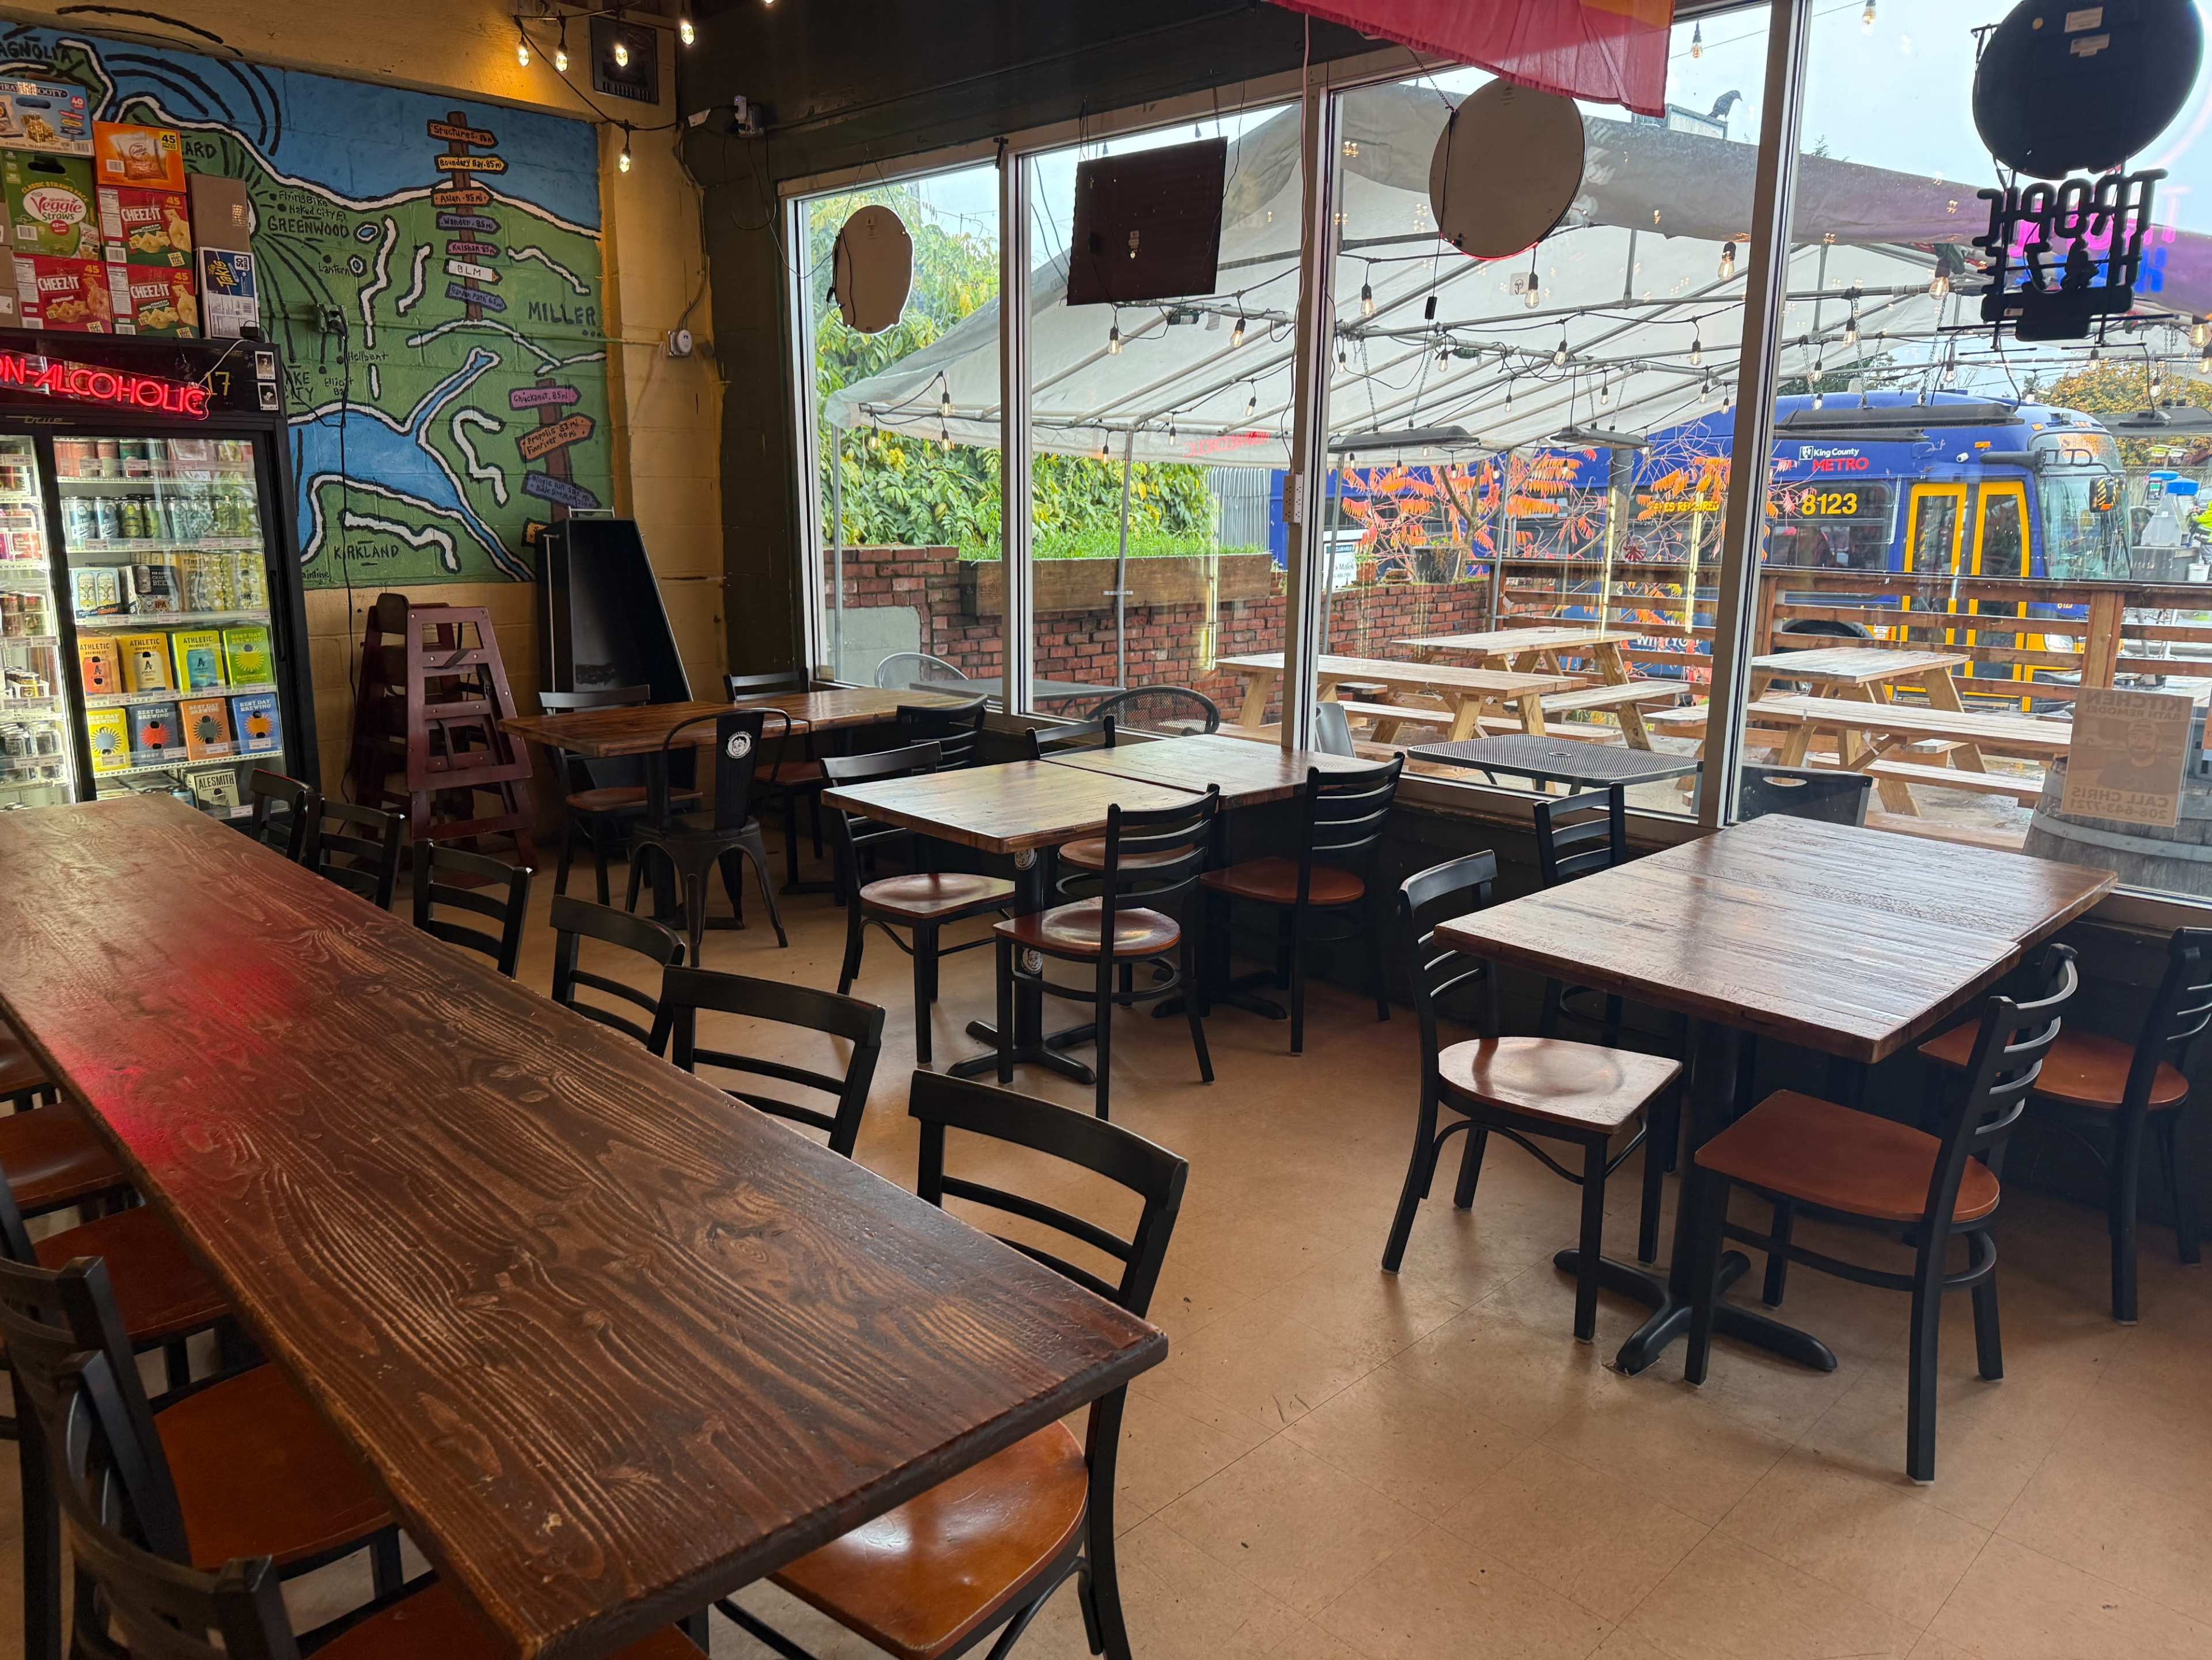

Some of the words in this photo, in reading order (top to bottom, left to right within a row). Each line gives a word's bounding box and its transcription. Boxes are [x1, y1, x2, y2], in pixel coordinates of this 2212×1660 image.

[161, 134, 176, 144] 45
[440, 158, 471, 167] Boundary
[472, 160, 483, 169] Bay
[166, 196, 181, 206] 45
[279, 191, 305, 204] Flying
[441, 195, 461, 203] Aslan
[465, 194, 475, 202] 85
[31, 196, 82, 214] Veggie
[289, 205, 314, 214] Naked
[42, 212, 75, 221] Straws
[120, 207, 162, 222] CHEEZ-IT
[268, 215, 350, 239] GREENWOOD
[443, 217, 471, 226] Wander
[236, 258, 244, 267] 50
[85, 264, 100, 274] 45
[319, 263, 350, 276] Lantern
[457, 264, 482, 277] BLM
[174, 272, 189, 281] 45
[37, 276, 80, 292] CHEEZ-IT
[130, 283, 170, 299] CHEEZ-IT
[528, 301, 596, 327] MILLER
[347, 350, 389, 362] Hellbent
[204, 371, 230, 396] 17
[285, 372, 310, 385] AKE
[324, 376, 355, 387] Elliot
[0, 356, 206, 415] N-ALCOHOLIC
[513, 391, 548, 403] Chuckanut
[552, 391, 560, 400] 85
[527, 428, 556, 445] Propolis
[527, 436, 556, 455] Finnriver
[1813, 449, 1831, 458] King
[1832, 448, 1860, 457] County
[1812, 457, 1870, 472] METRO
[1801, 493, 1858, 515] 8123
[334, 544, 399, 560] KRKLAND
[301, 568, 329, 579] ainline
[154, 600, 167, 608] IPA
[130, 638, 160, 646] ATHLETIC
[183, 636, 213, 644] ATHLETIC
[79, 642, 110, 651] ATHLETIC
[240, 704, 271, 712] BREWING
[199, 773, 234, 789] ALESMITH
